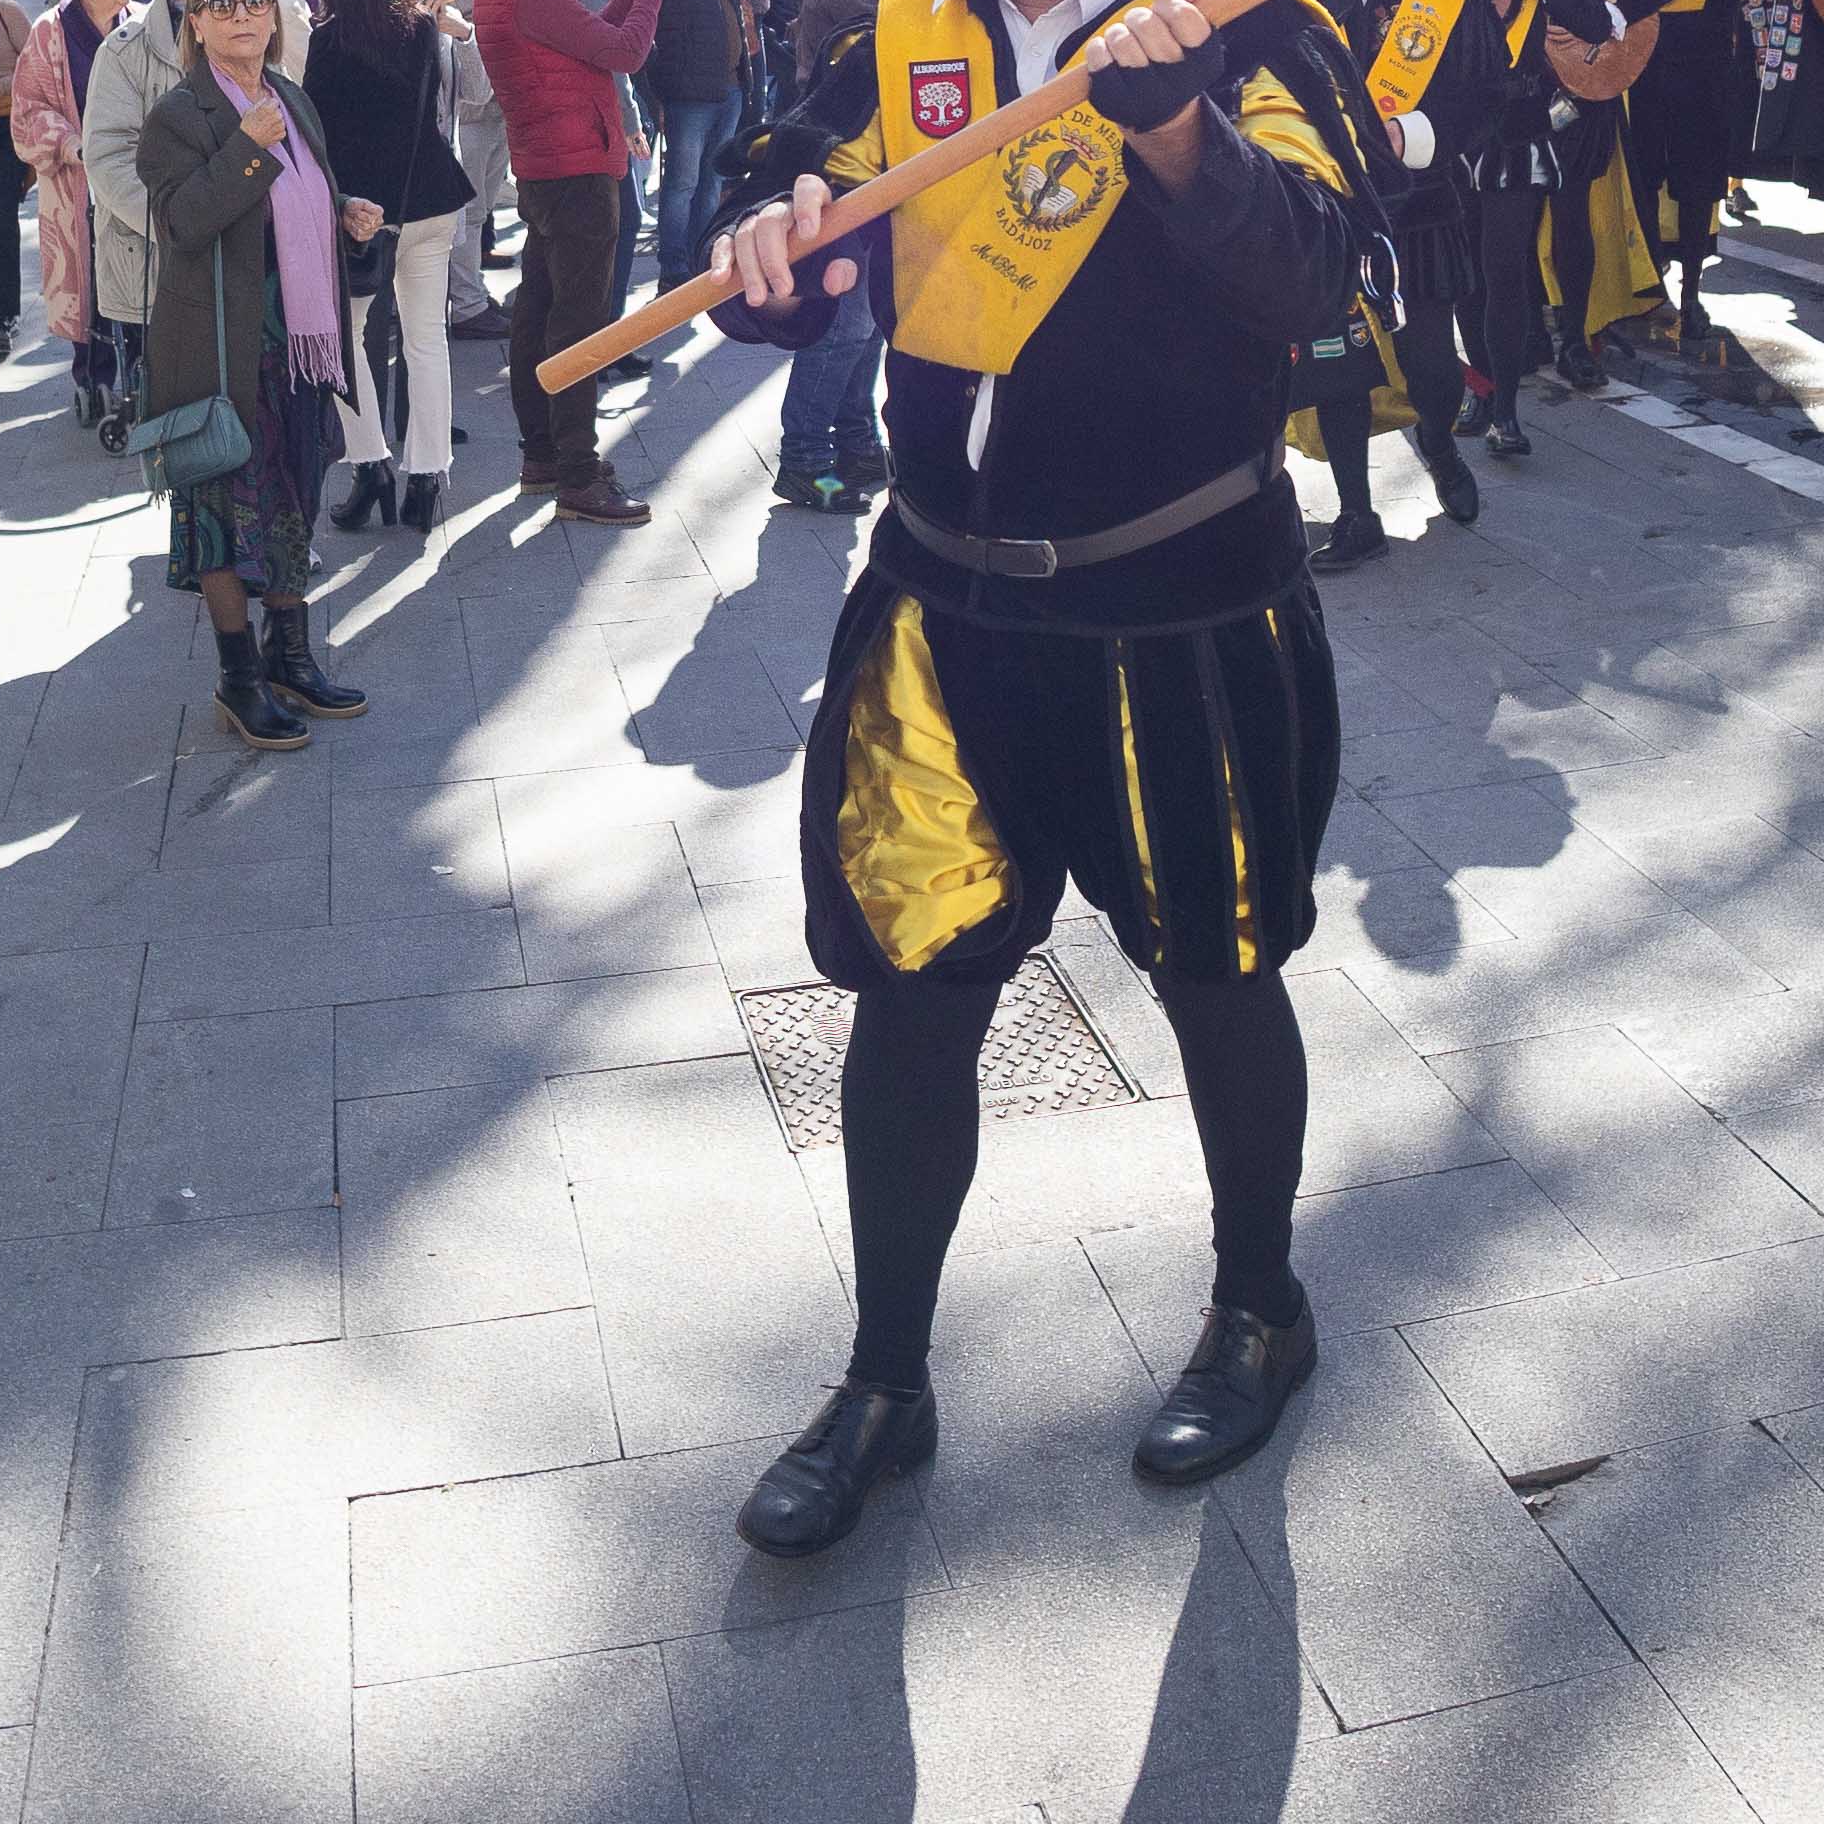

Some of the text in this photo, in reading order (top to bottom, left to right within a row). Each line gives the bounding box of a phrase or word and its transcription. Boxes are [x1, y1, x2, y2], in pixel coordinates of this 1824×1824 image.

[912, 61, 966, 75] ALBURQUERQUE
[1071, 109, 1094, 128] DE
[995, 206, 1053, 252] BADAJOZ
